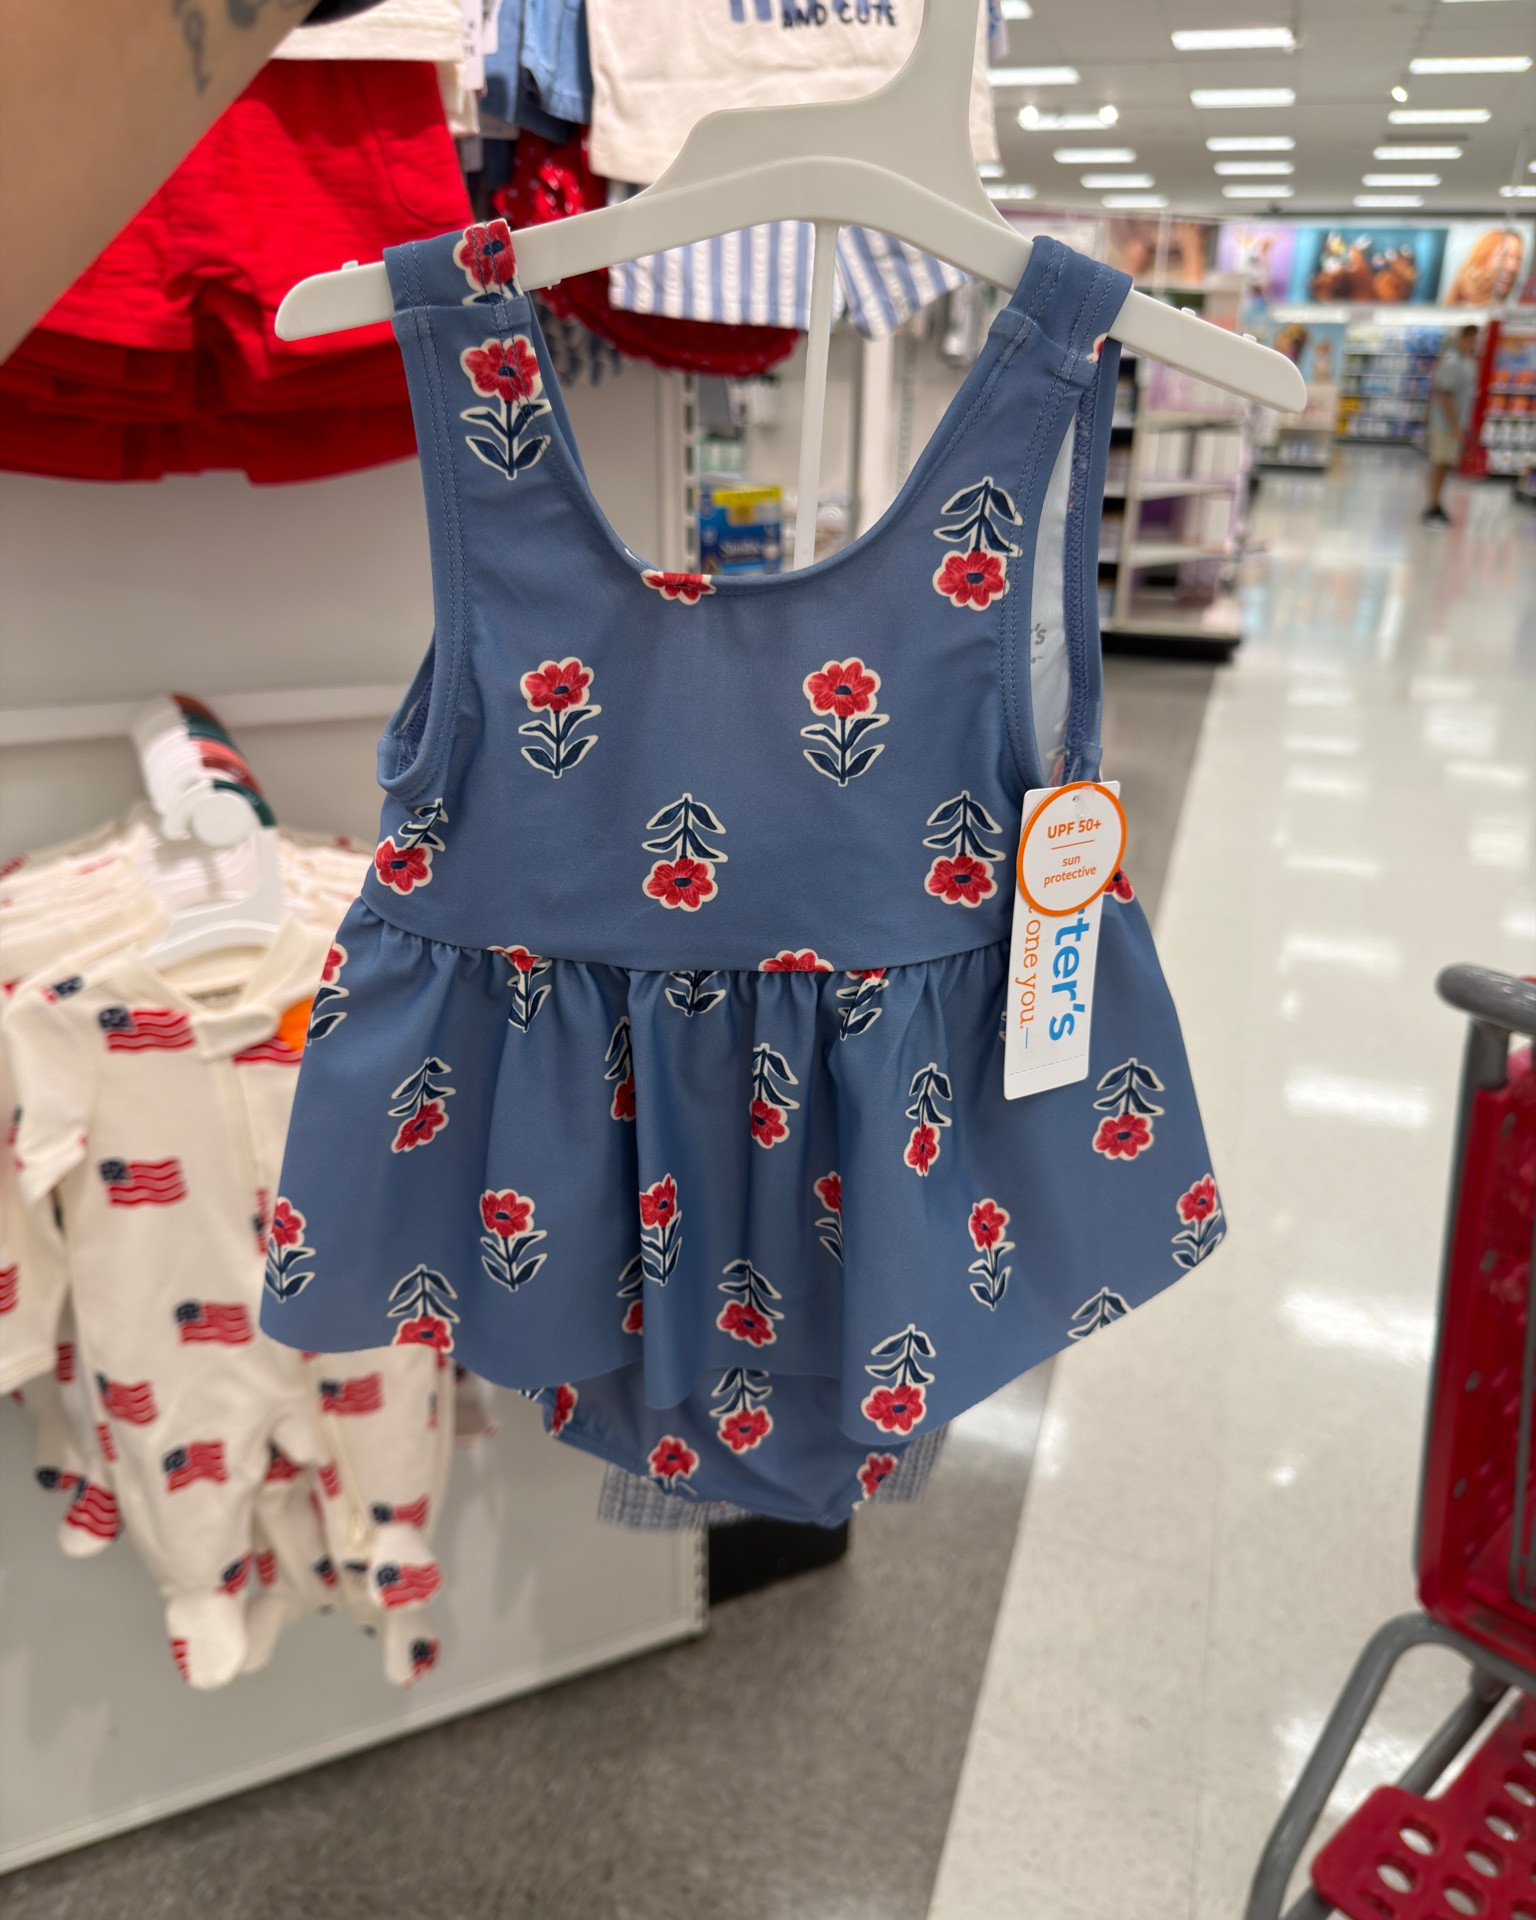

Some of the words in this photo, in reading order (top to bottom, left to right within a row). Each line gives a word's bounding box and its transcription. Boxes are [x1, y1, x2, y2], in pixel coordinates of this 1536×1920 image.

[783, 3, 828, 28] AND
[839, 2, 896, 26] CUTE
[1047, 821, 1075, 839] UPF
[1077, 818, 1101, 833] 50+
[1062, 855, 1080, 867] sun
[1043, 866, 1096, 888] protective
[1023, 919, 1040, 968] one
[1049, 908, 1089, 1041] ter's
